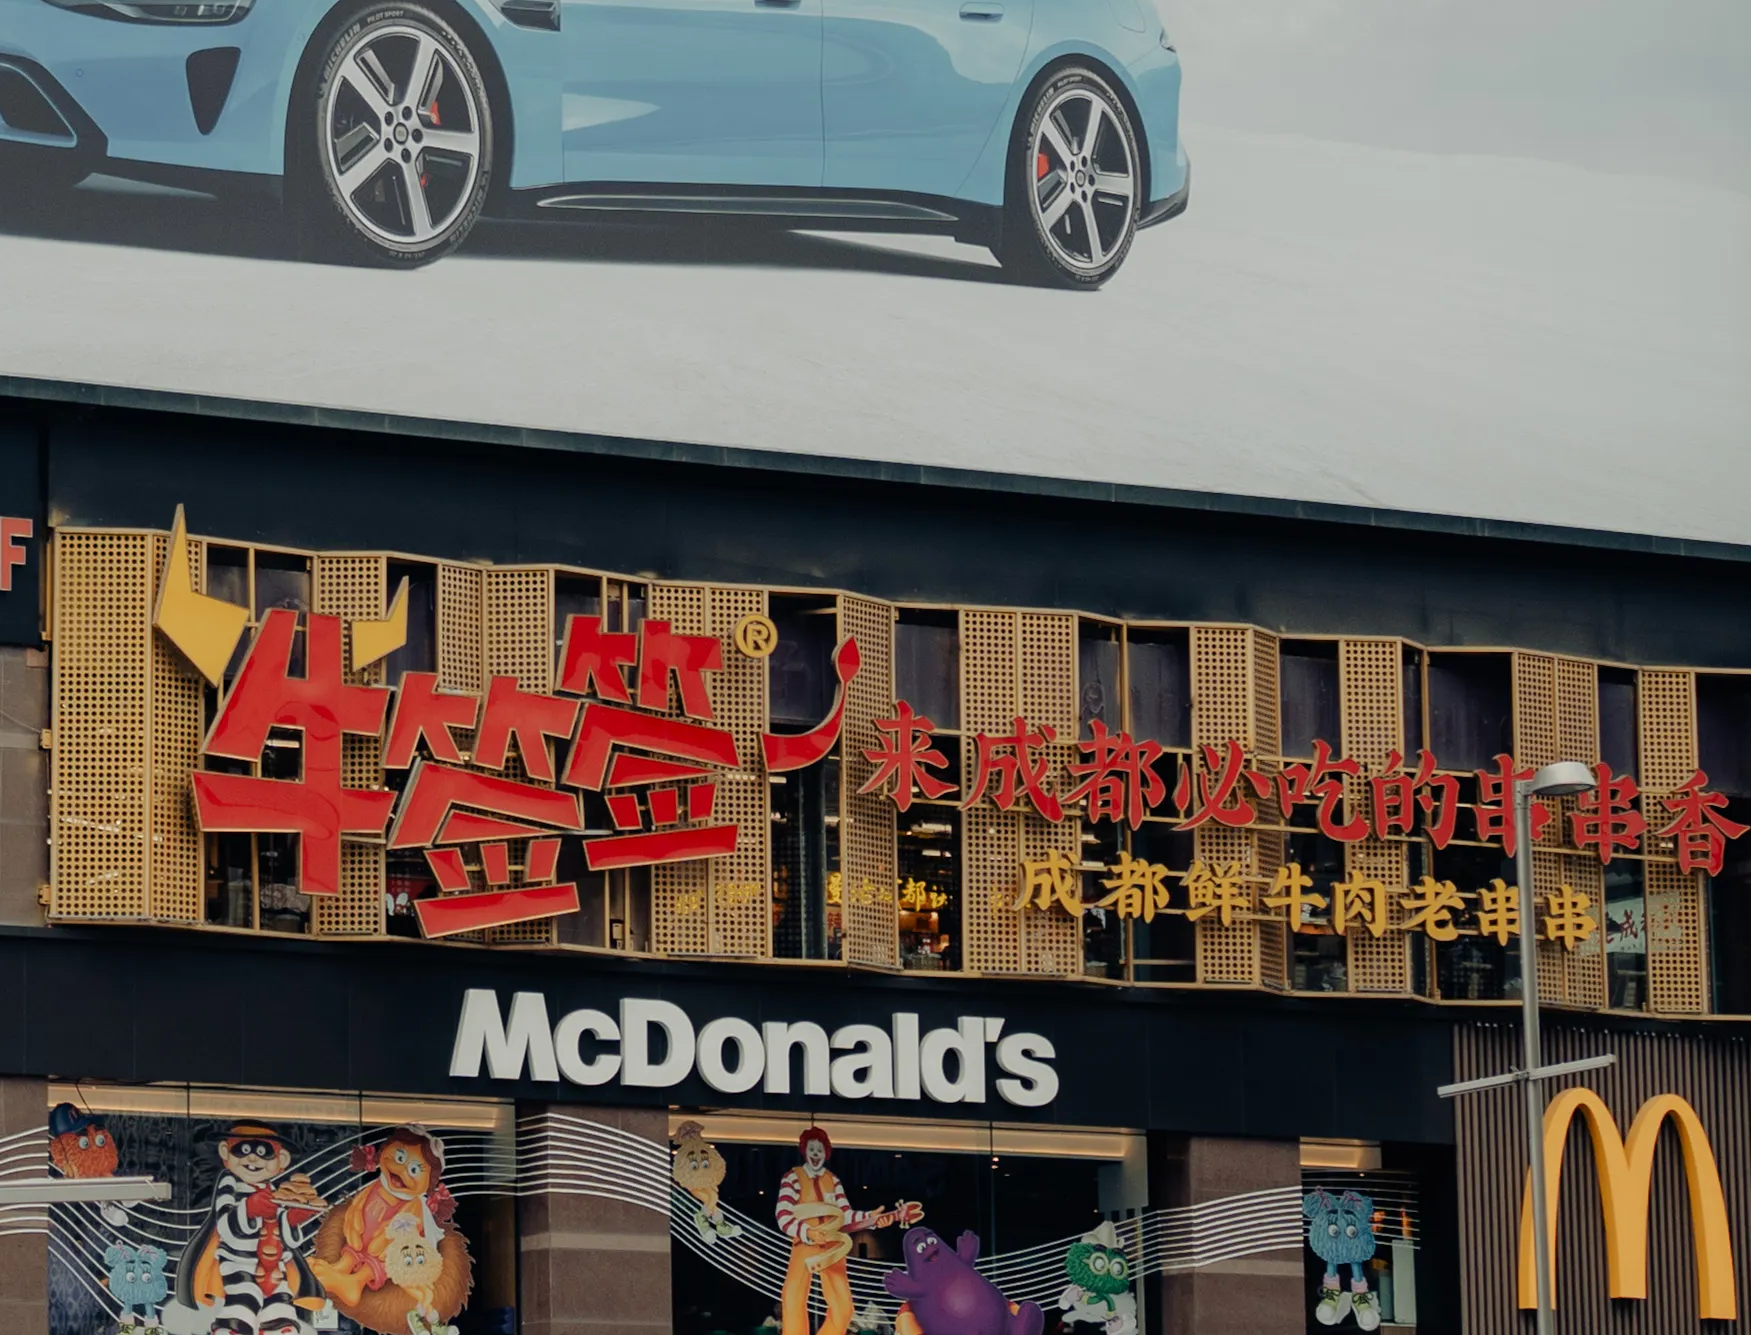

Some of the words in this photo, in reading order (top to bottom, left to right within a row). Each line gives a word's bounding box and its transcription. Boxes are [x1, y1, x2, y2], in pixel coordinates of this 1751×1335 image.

[190, 608, 742, 940] 牛签签
[857, 698, 1750, 877] 来成都必吃的串串香
[1012, 849, 1598, 953] 成都鲜牛肉老串串
[448, 987, 1059, 1108] McDonald's
